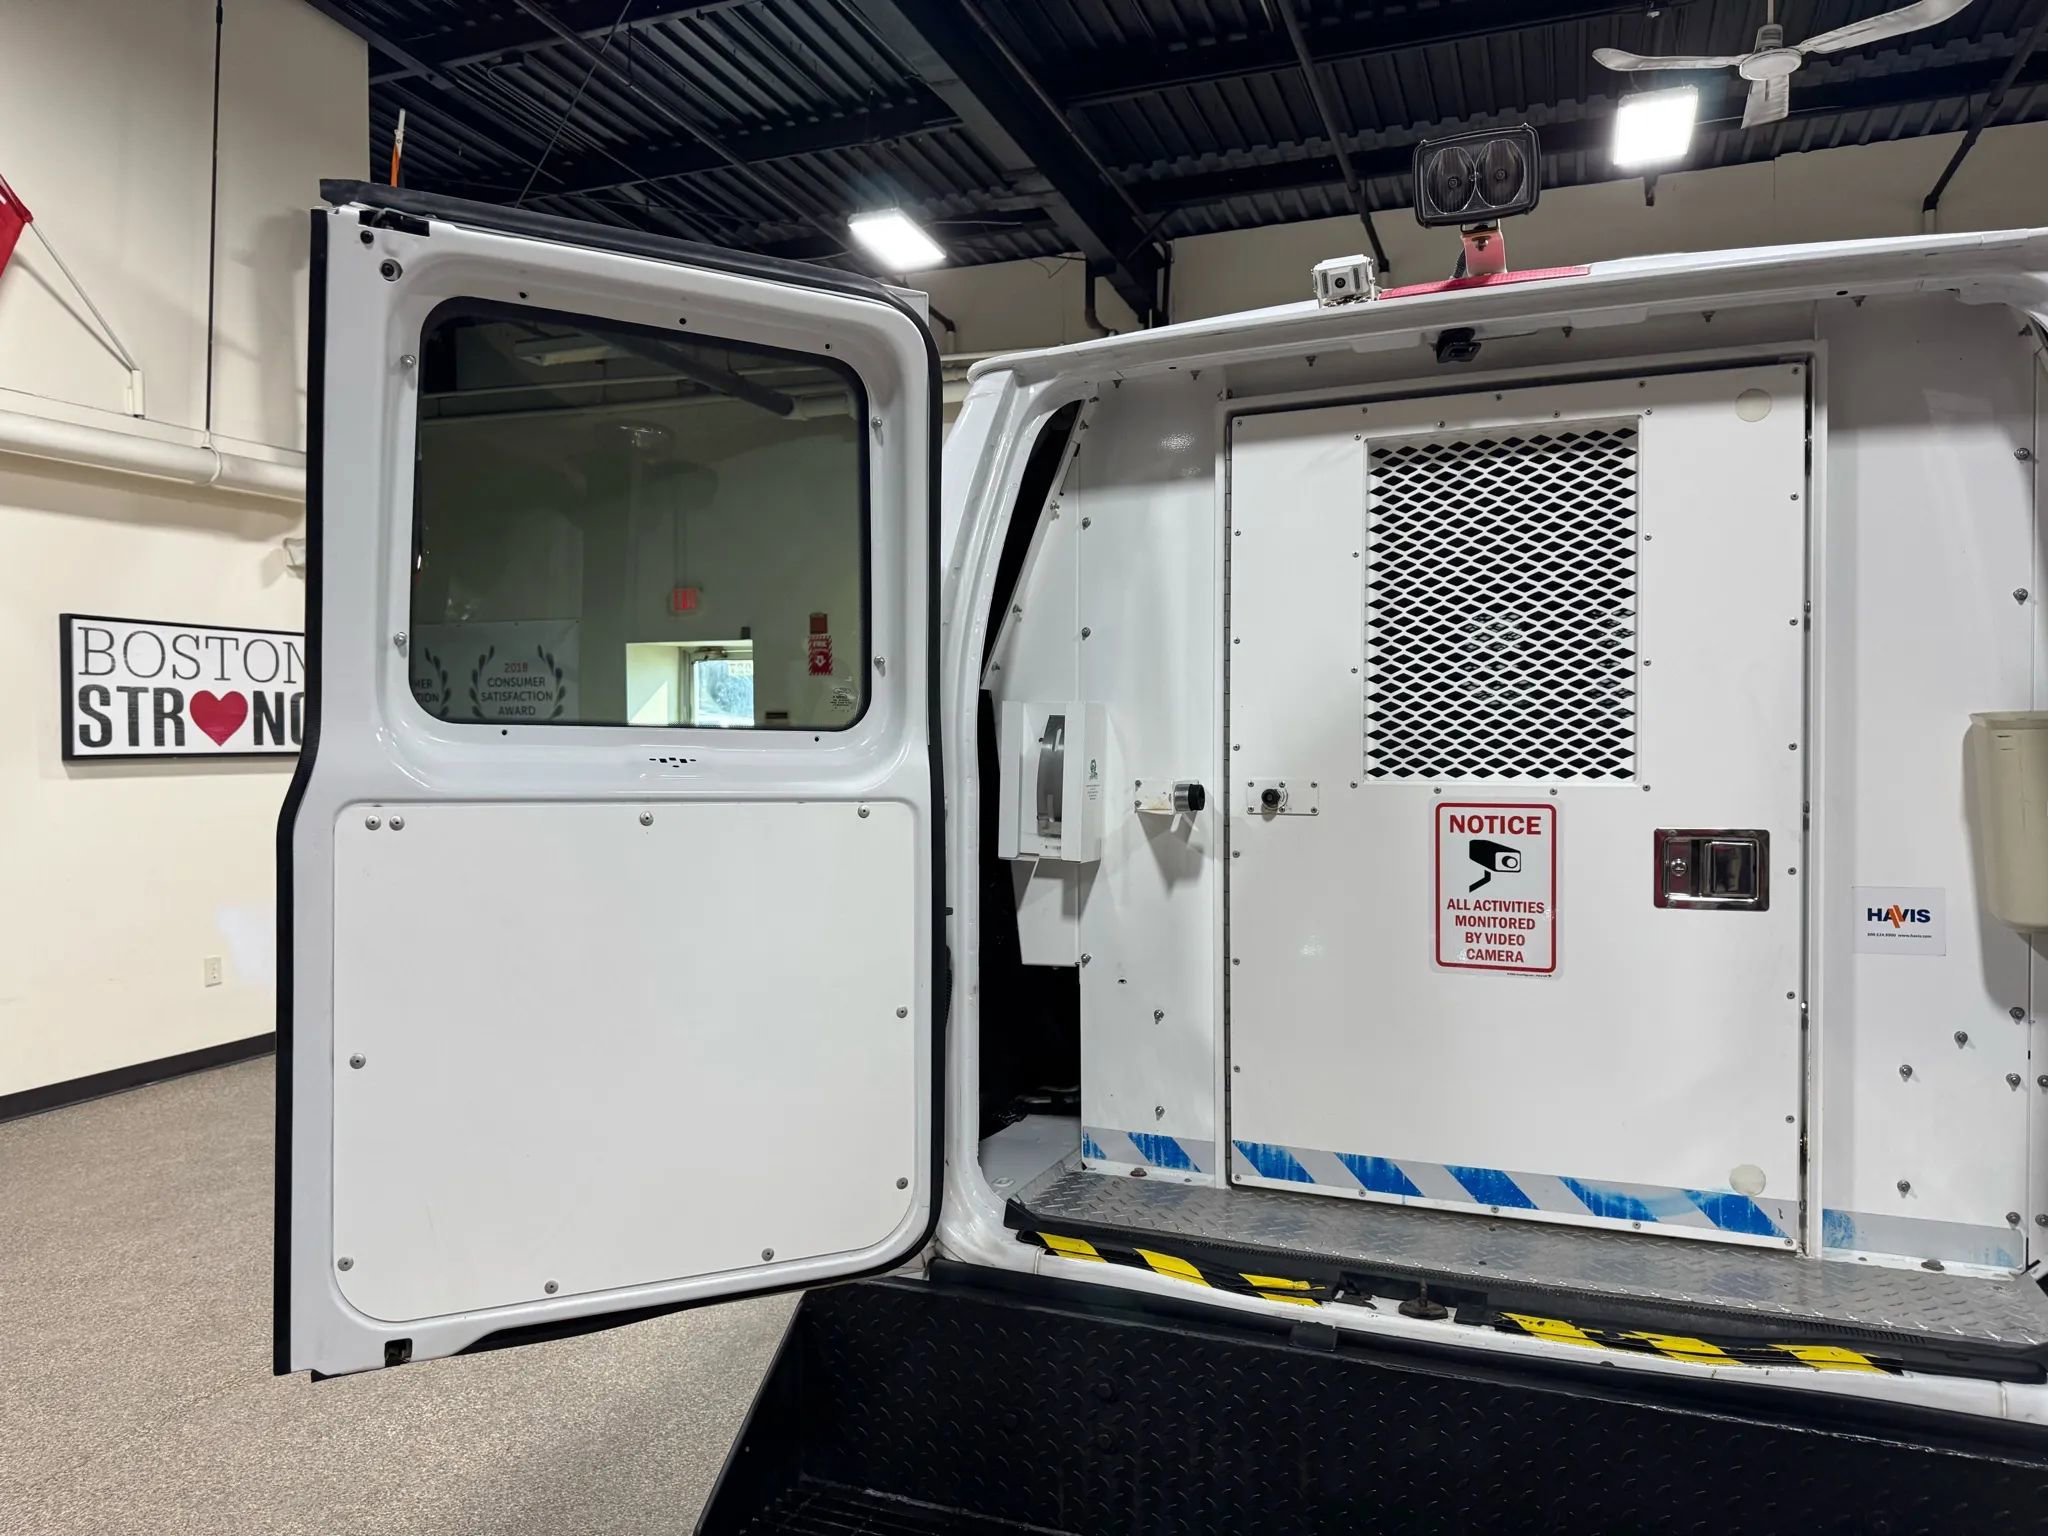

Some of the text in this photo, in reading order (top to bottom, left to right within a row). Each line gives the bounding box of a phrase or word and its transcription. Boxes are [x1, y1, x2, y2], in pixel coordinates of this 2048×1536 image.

[78, 627, 305, 684] BOSTON
[504, 662, 529, 673] 2018
[487, 677, 546, 687] CONSUMER
[481, 691, 553, 702] SATISFACTION
[498, 705, 536, 716] AWARD
[1449, 815, 1542, 835] NOTICE
[1447, 898, 1545, 914] ALL ACTIVITIES
[1455, 915, 1536, 930] MONITORED
[1867, 905, 1931, 928] HAVIS
[1465, 932, 1526, 946] BY VIDEO
[1466, 948, 1524, 963] CAMERA
